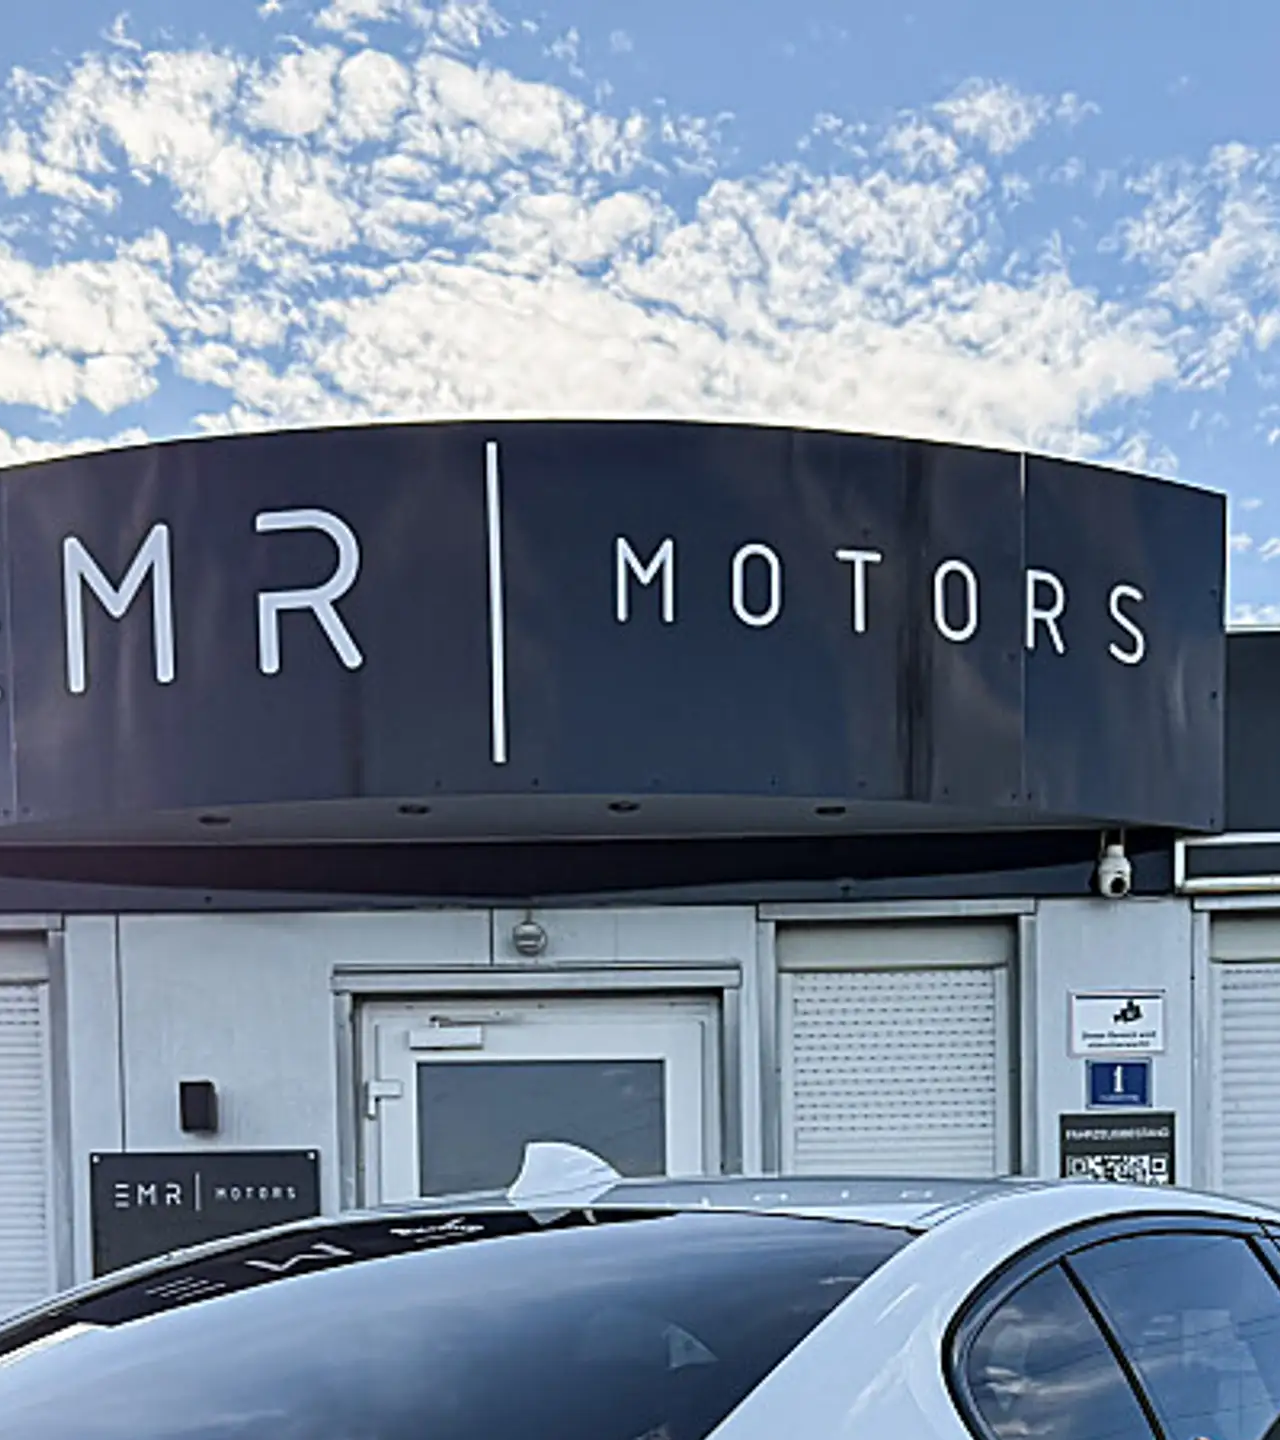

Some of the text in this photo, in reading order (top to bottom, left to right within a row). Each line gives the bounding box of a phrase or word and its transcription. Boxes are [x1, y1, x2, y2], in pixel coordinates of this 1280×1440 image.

[613, 536, 1148, 667] MOTORS
[1112, 1065, 1124, 1093] 1
[114, 1181, 298, 1209] EMR MOTORS
